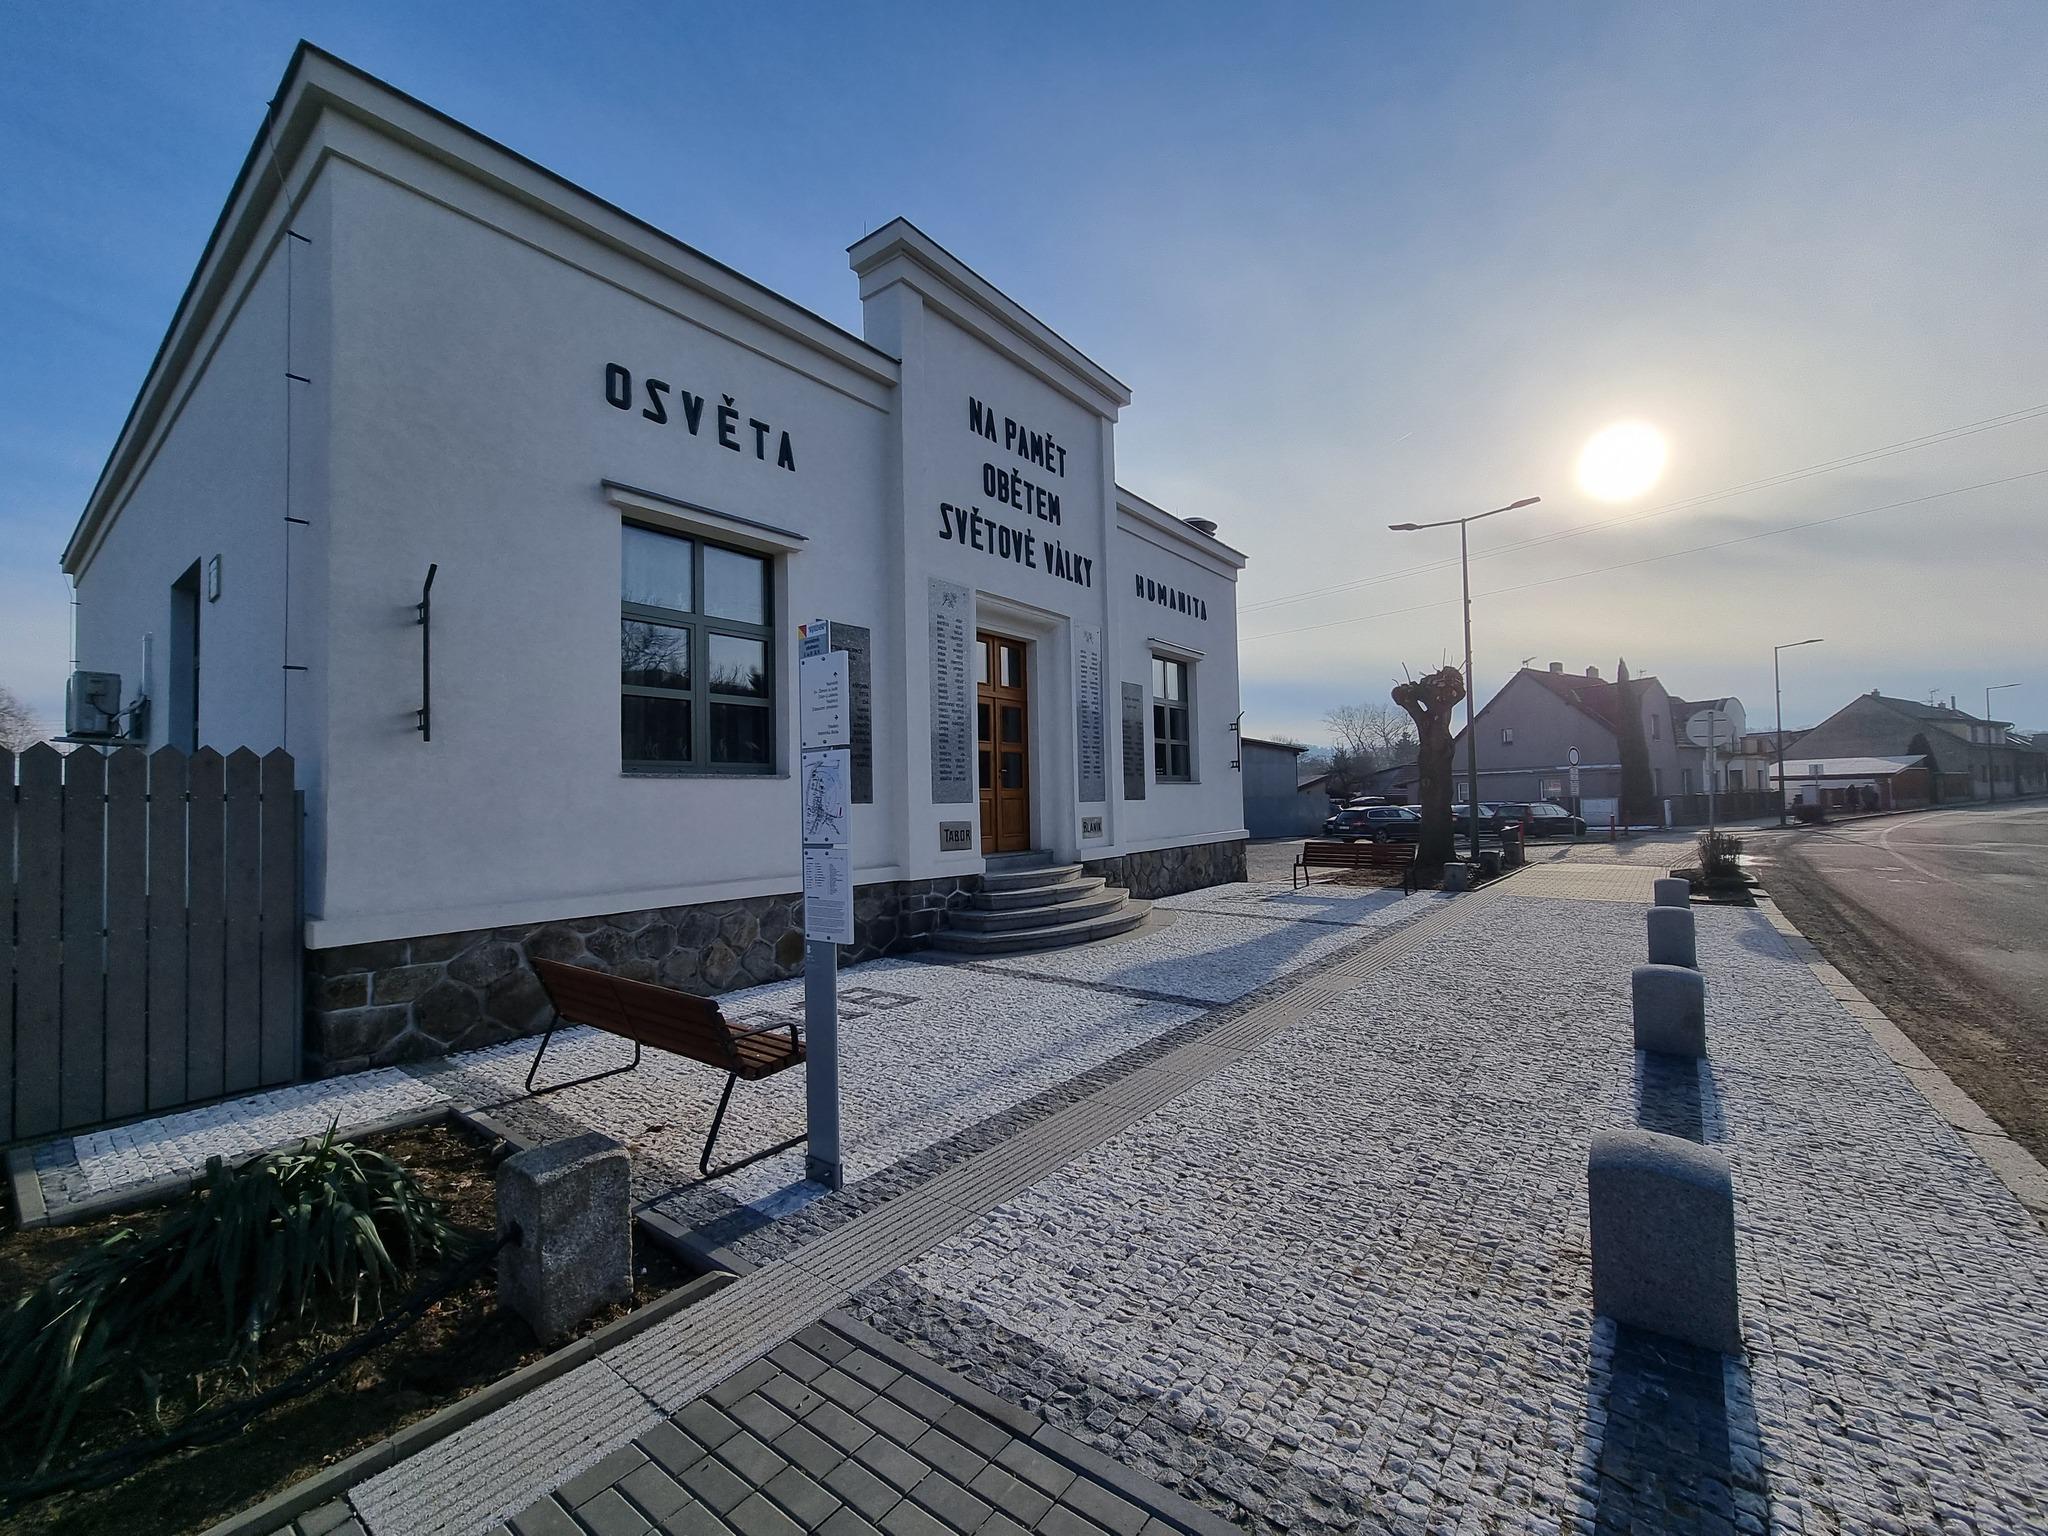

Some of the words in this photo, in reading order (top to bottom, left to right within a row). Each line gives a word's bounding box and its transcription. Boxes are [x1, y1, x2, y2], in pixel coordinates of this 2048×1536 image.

[605, 362, 796, 472] OSVĚTA
[969, 396, 997, 443] NA
[1004, 416, 1067, 478] PAMĚT
[983, 462, 1061, 526] OBĚTEM
[938, 502, 1036, 569] SVĚTOVÉ
[1043, 540, 1092, 588] VÁLKY
[1135, 573, 1207, 622] HUMANITA
